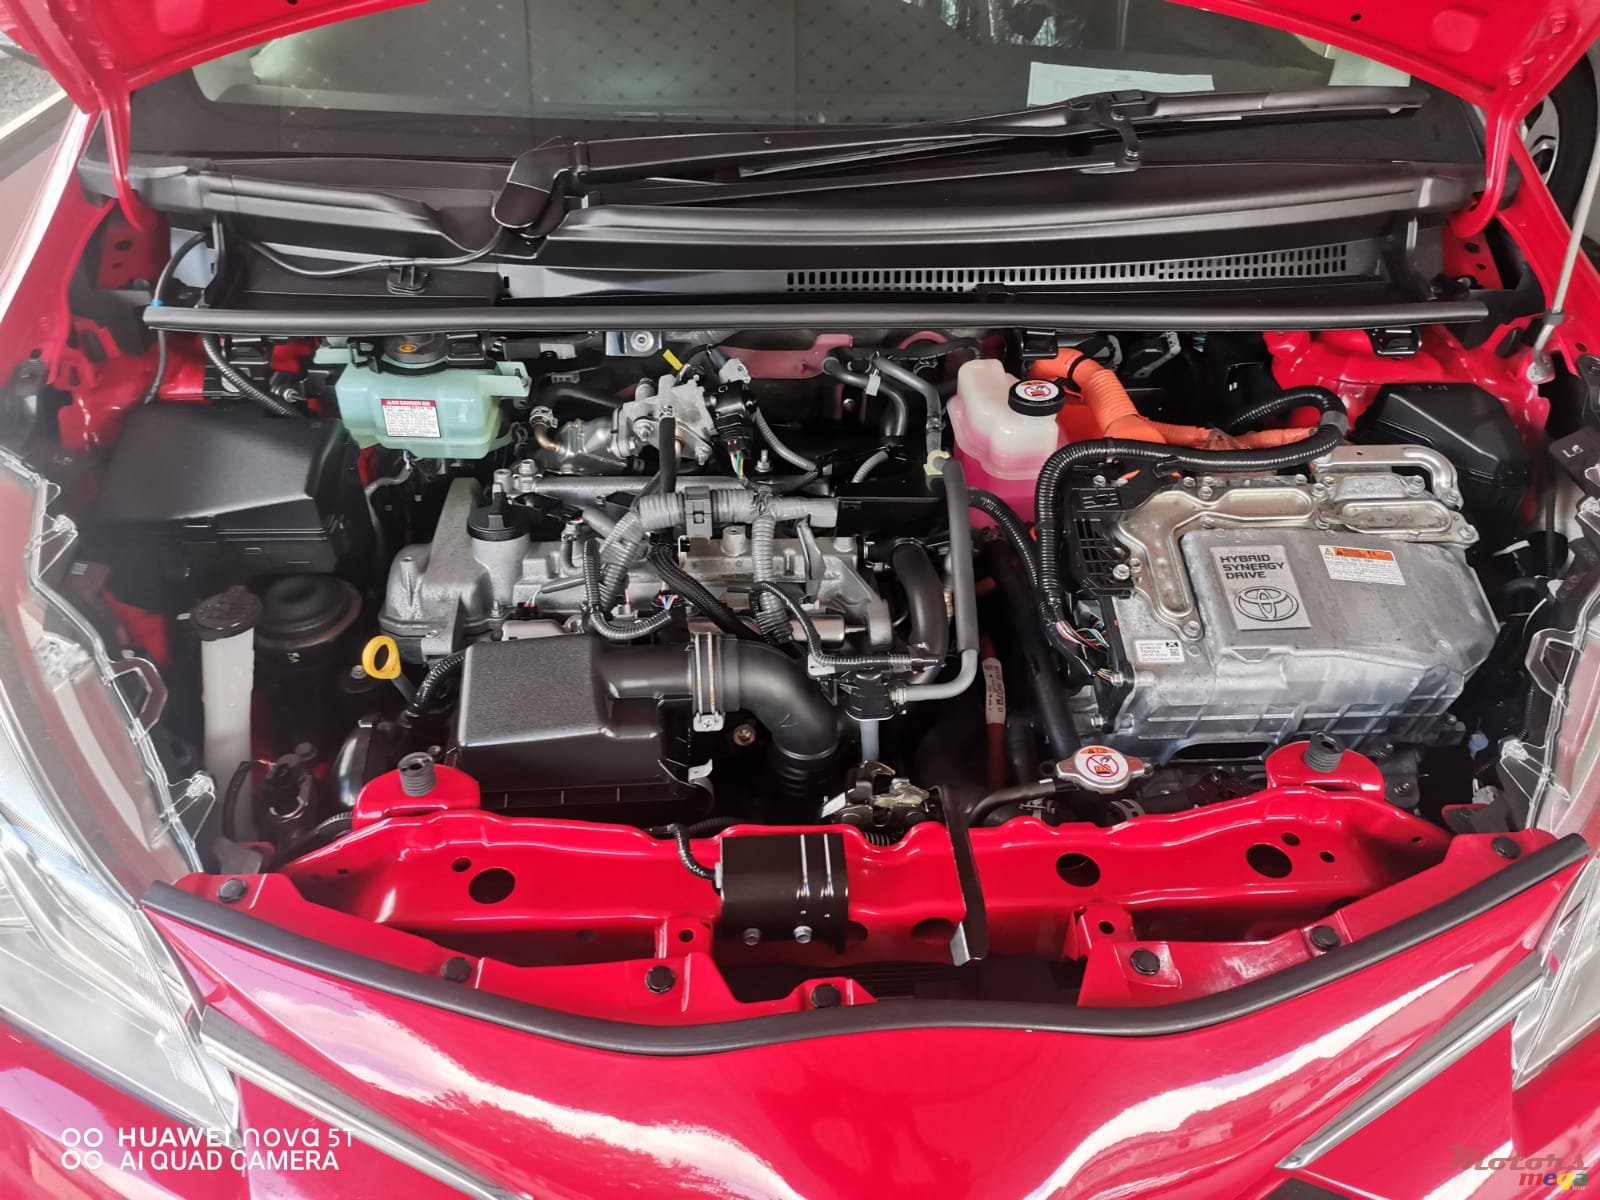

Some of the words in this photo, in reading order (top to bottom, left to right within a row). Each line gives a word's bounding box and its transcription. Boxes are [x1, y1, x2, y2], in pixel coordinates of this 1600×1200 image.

[1219, 554, 1271, 563] HYBRID
[1222, 562, 1284, 572] SYNERGY
[1225, 571, 1267, 580] DRIVE
